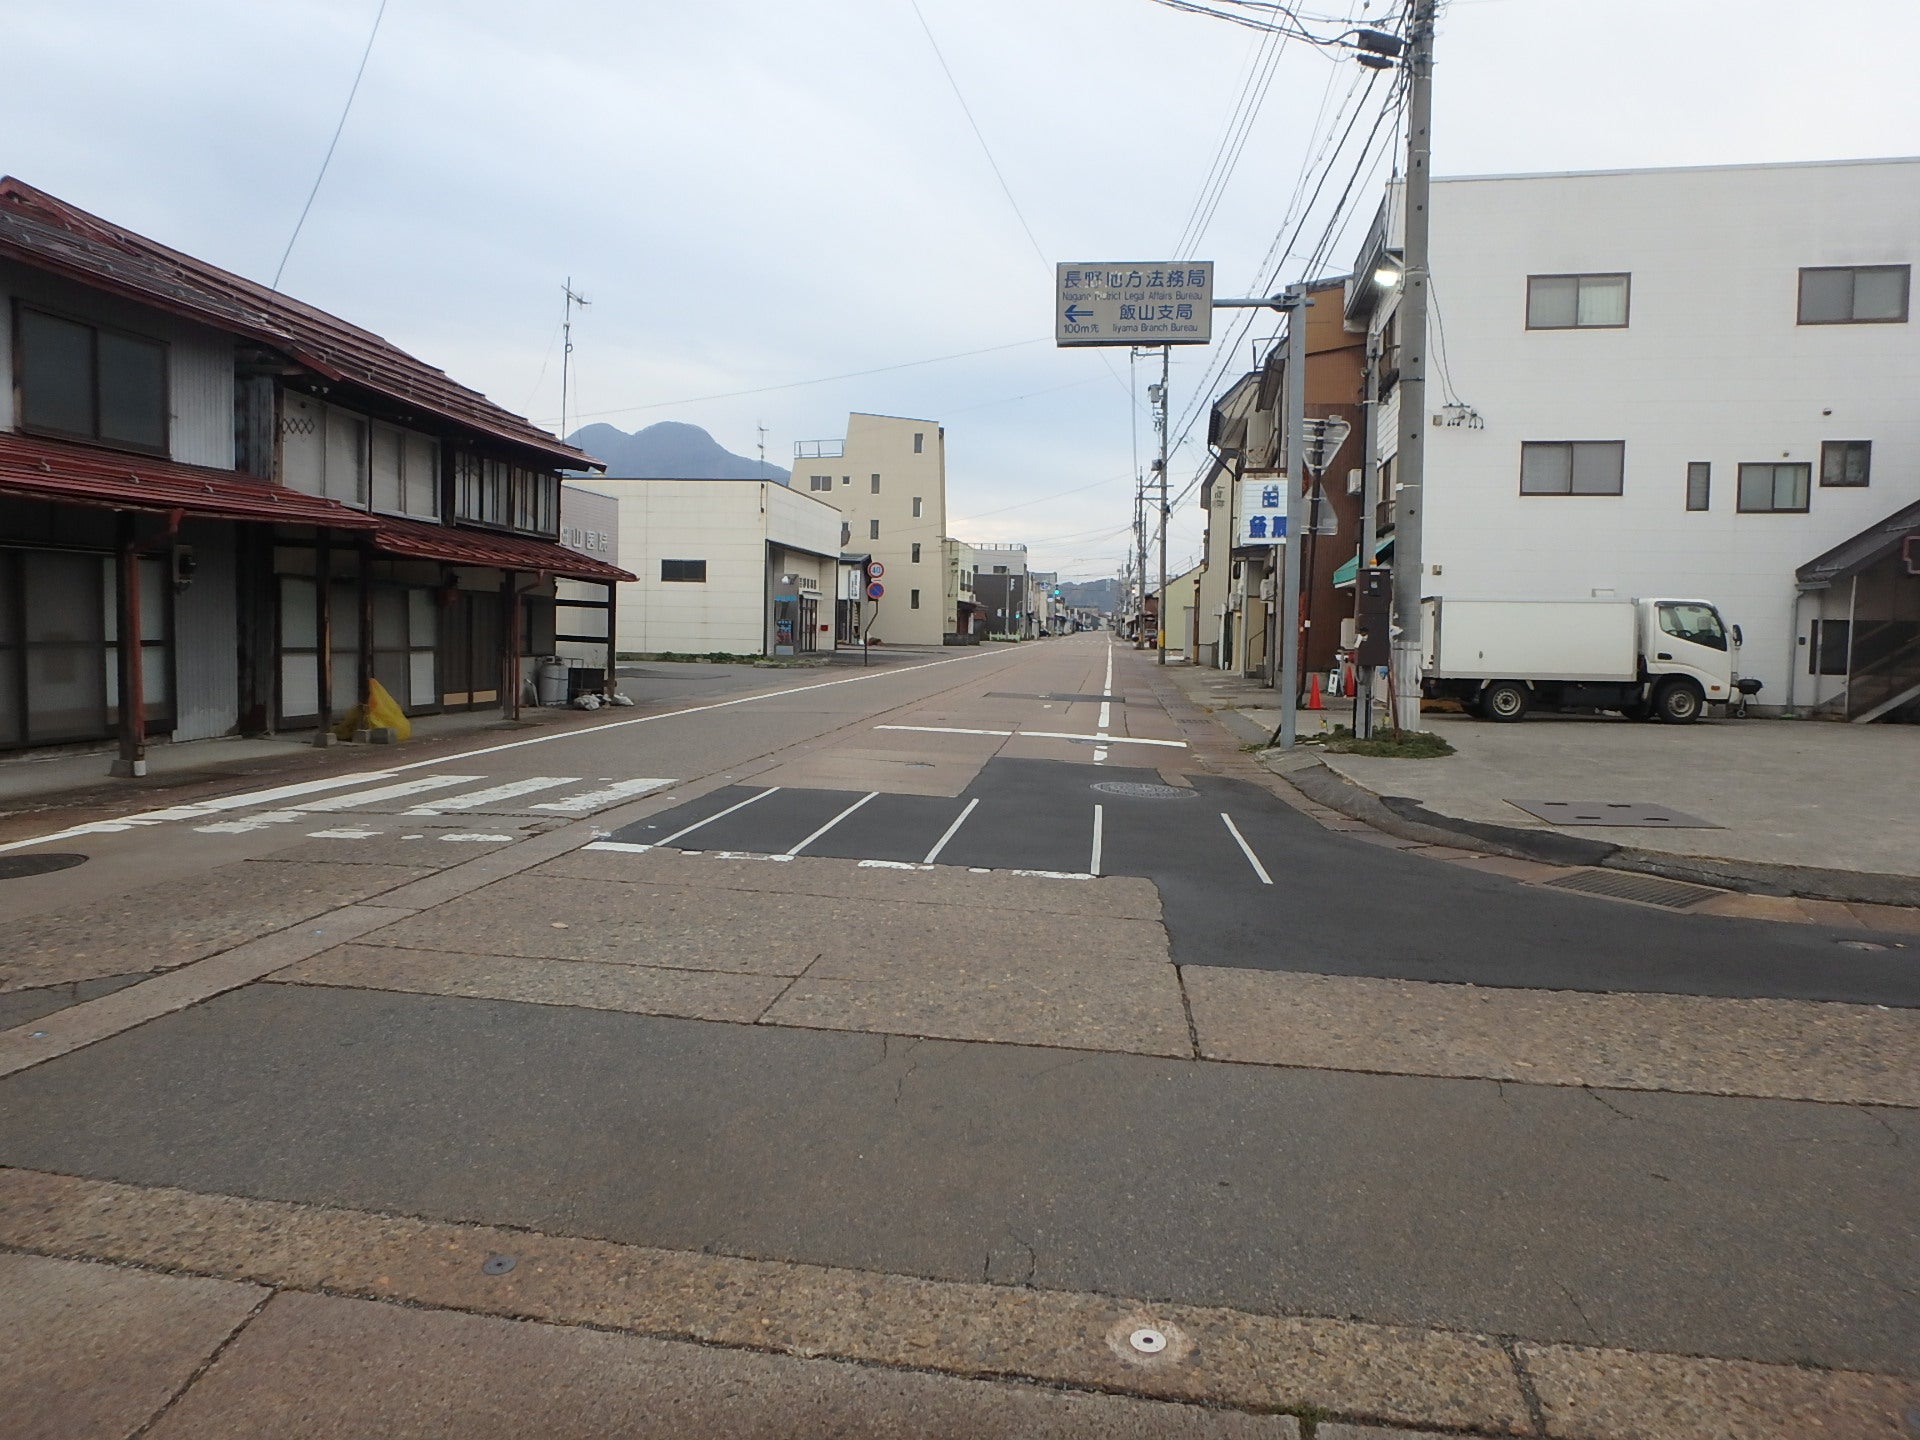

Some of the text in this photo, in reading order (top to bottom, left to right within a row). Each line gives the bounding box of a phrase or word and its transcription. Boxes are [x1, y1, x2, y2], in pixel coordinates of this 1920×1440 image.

[1064, 270, 1206, 288] 長野地方法務局
[1063, 291, 1202, 302] Nagano Dtrict Legal Affairs Bureau
[1120, 304, 1193, 320] 飯山支局
[1063, 324, 1100, 334] 100m先
[1112, 323, 1198, 333] Iiyama Branch Bureau
[872, 566, 881, 574] 40
